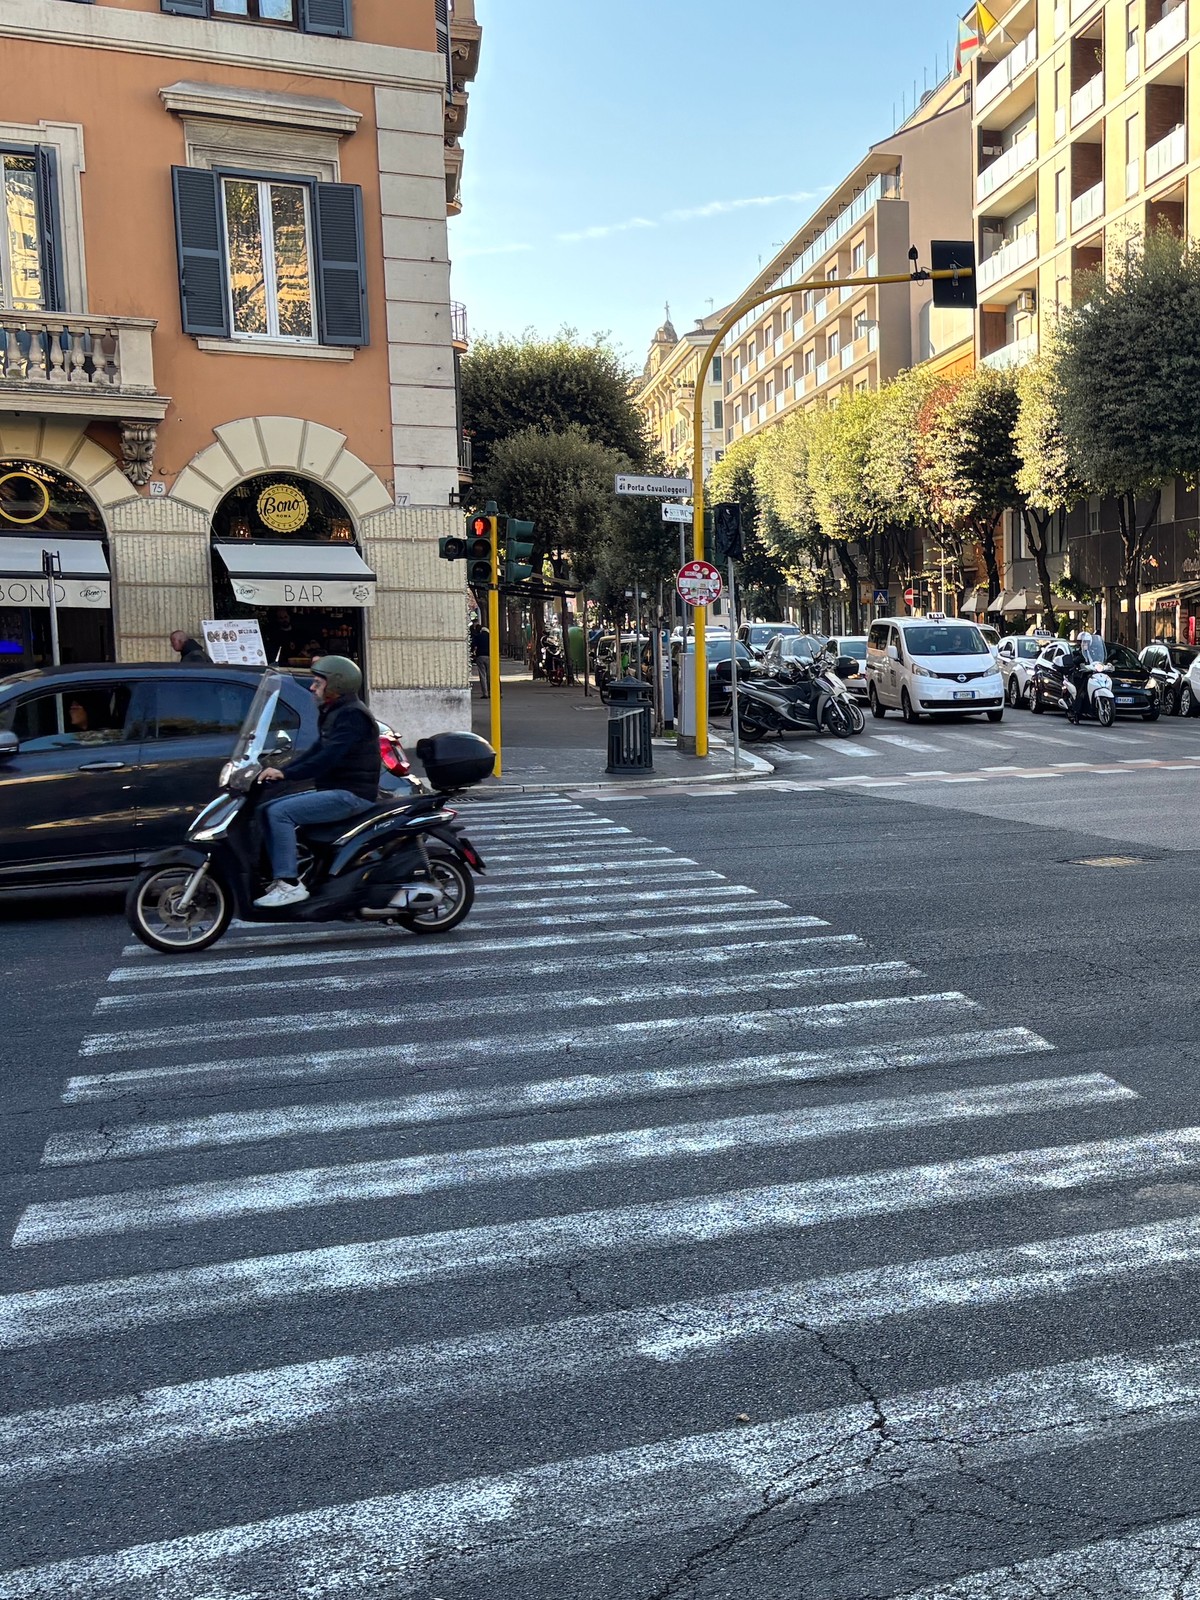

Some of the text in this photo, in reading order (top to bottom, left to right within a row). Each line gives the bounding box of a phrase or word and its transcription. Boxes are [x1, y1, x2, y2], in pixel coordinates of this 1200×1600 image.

[151, 483, 163, 493] 75
[618, 483, 688, 495] di Porta Cavalleggeri
[397, 495, 408, 505] 77
[262, 496, 302, 517] Bono
[284, 584, 323, 602] BAR
[1160, 600, 1180, 609] PIZZA
